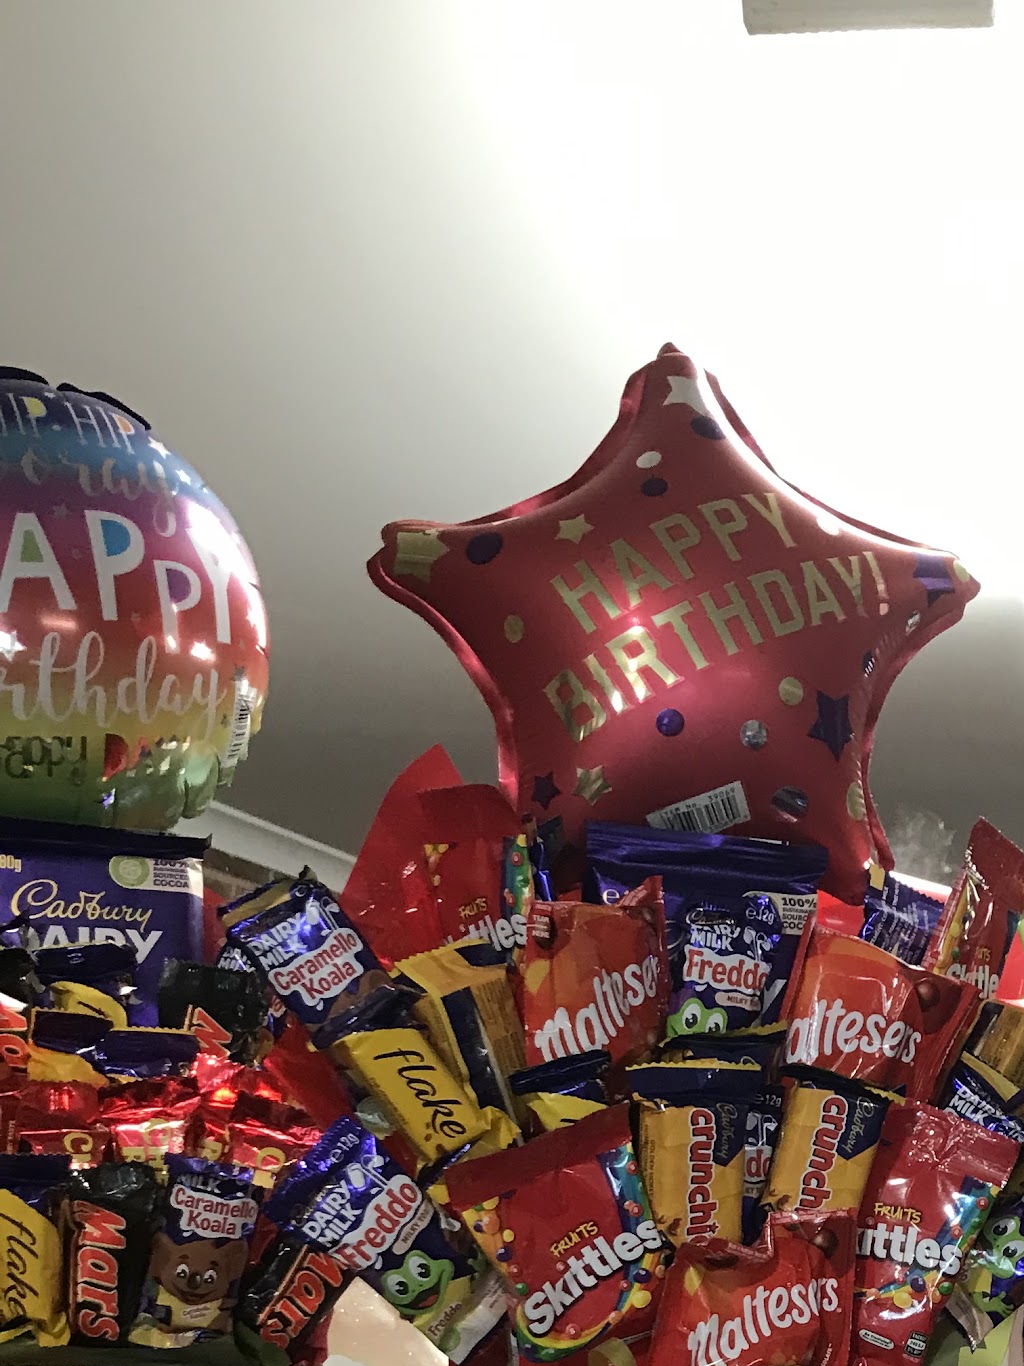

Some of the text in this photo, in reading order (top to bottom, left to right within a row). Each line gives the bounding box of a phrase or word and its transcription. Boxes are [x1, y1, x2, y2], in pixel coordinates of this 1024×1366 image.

[64, 401, 136, 455] HIP
[0, 509, 238, 645] APPY
[551, 492, 798, 634] HAPPY
[542, 551, 890, 742] BIRTHDAY!
[0, 630, 228, 738] rthday
[11, 879, 153, 932] Cadbury
[153, 880, 190, 888] COCOA
[781, 897, 817, 908] 100%
[250, 915, 302, 955] DAIRY
[258, 941, 308, 971] MILK
[272, 929, 358, 991] Caramello
[690, 932, 735, 952] MILK
[301, 960, 357, 1000] Koala
[949, 1092, 985, 1126] MILK
[798, 1094, 848, 1212] Crunch
[187, 1210, 237, 1235] Koala
[302, 1180, 352, 1240] DAIRY
[317, 1205, 363, 1247] MILK
[337, 1181, 419, 1269] Freddo
[874, 1201, 923, 1225] FRUITS
[551, 1221, 600, 1258] FRUITS
[74, 1200, 127, 1342] Mars
[524, 1220, 663, 1336] Skittles
